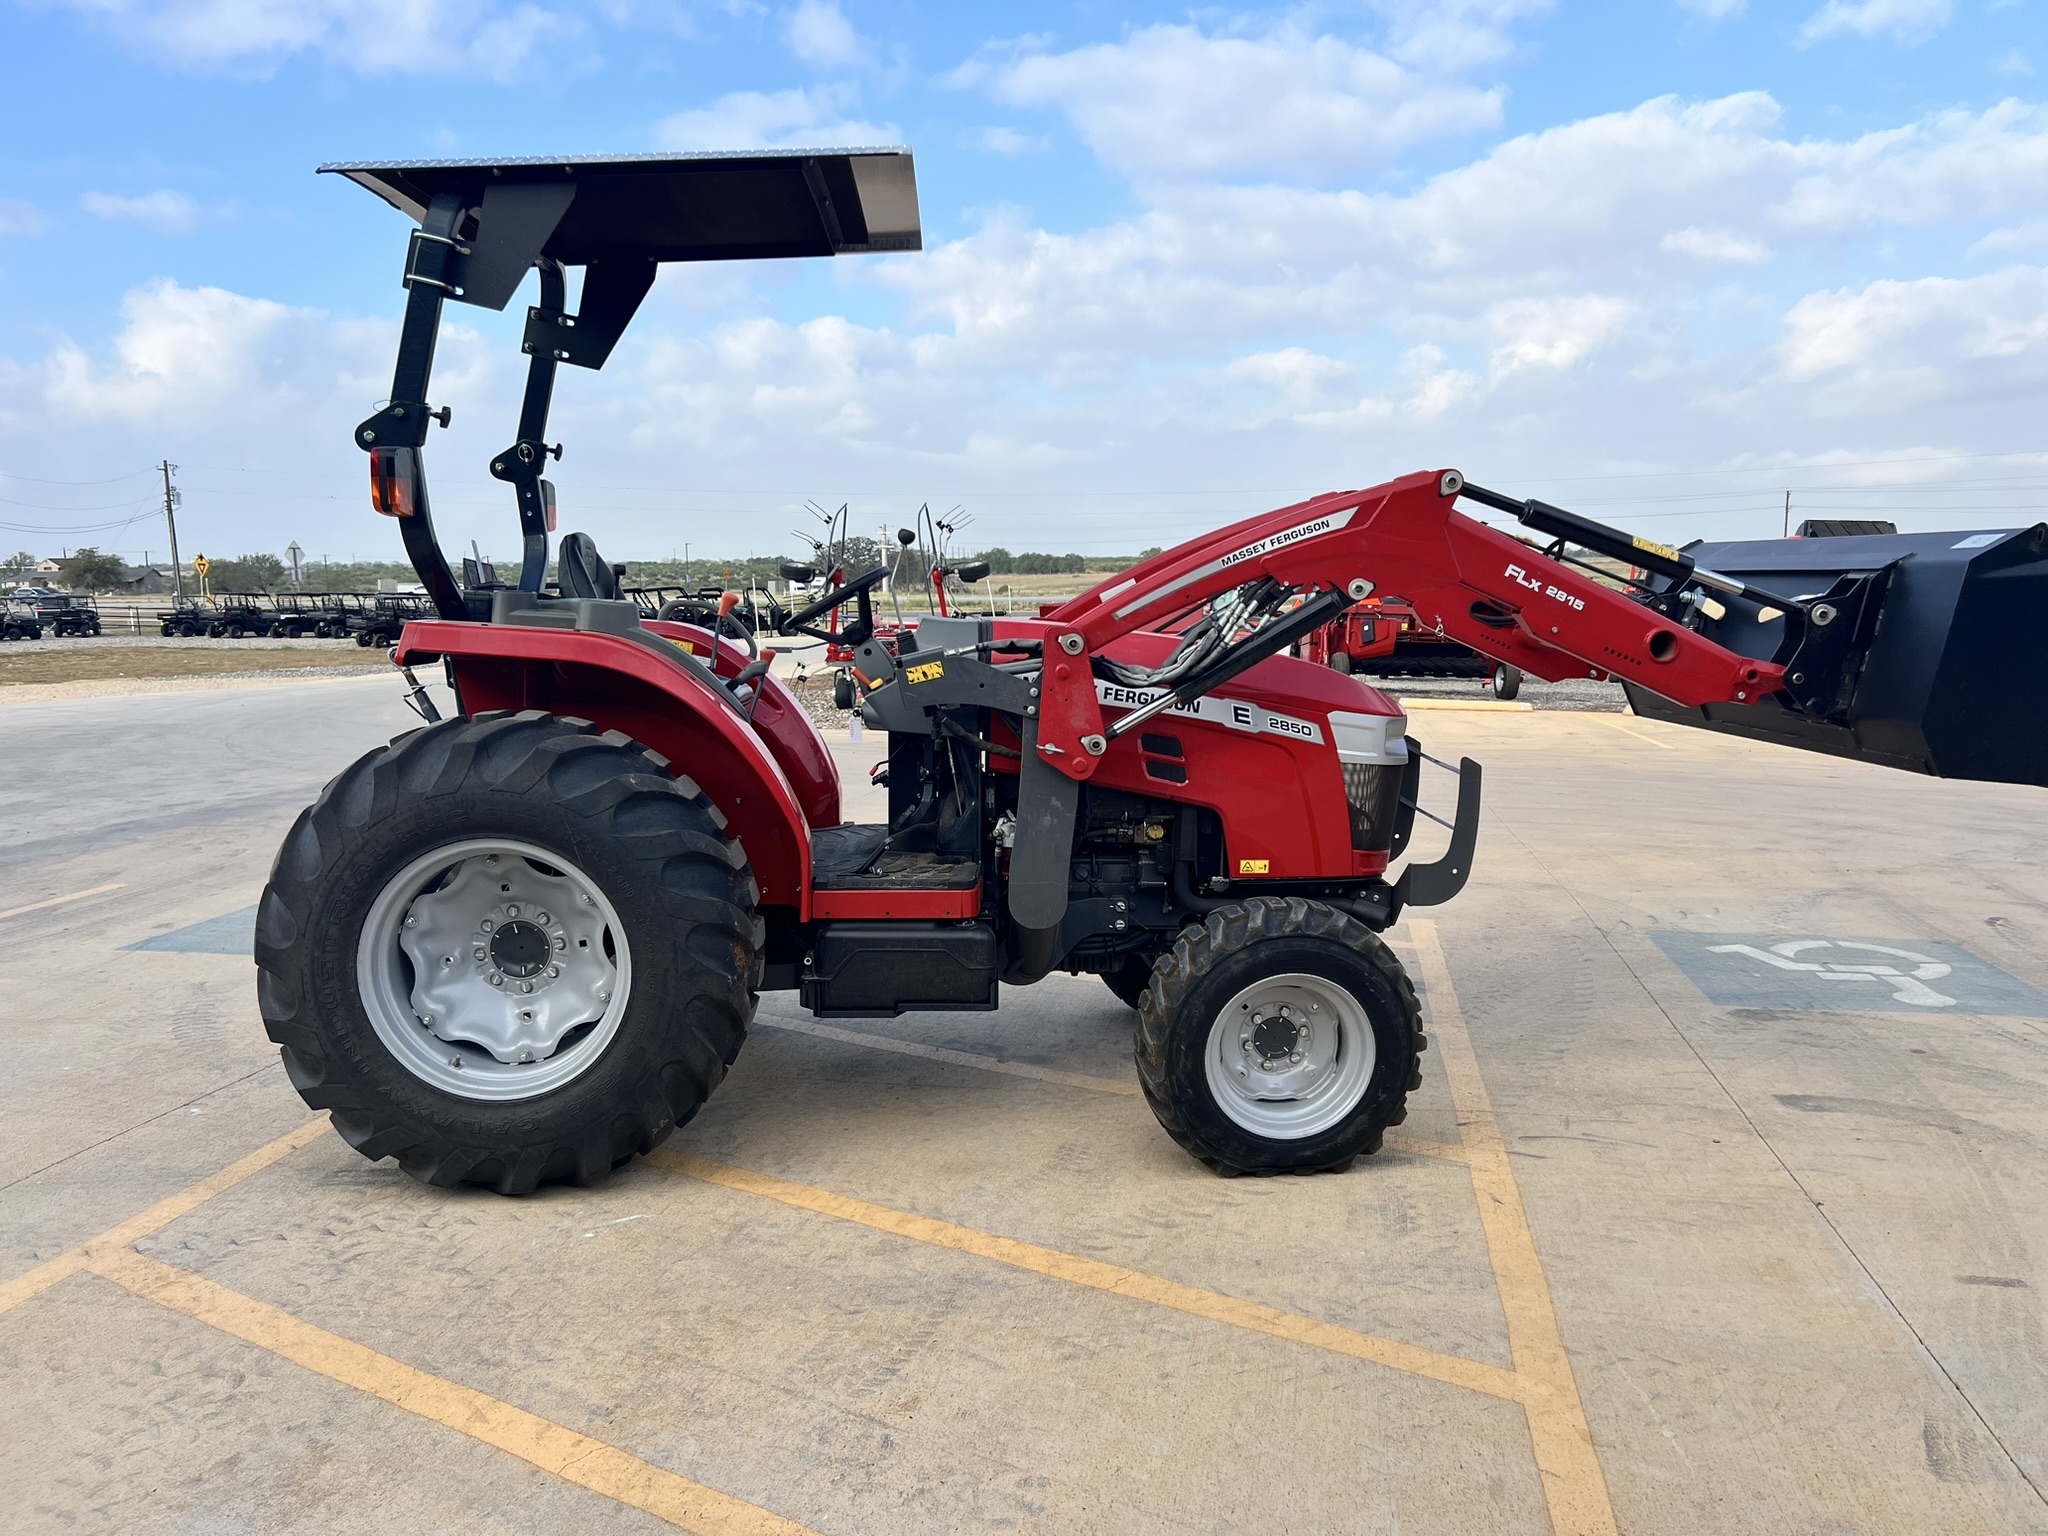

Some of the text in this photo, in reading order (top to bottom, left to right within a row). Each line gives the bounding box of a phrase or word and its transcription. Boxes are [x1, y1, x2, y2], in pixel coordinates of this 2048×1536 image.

[1221, 519, 1331, 567] MASSEY FERGUSON
[1545, 585, 1585, 611] 2815
[1233, 706, 1251, 725] E
[1269, 717, 1312, 737] 2850
[320, 847, 393, 1076] INDUSTRIAL
